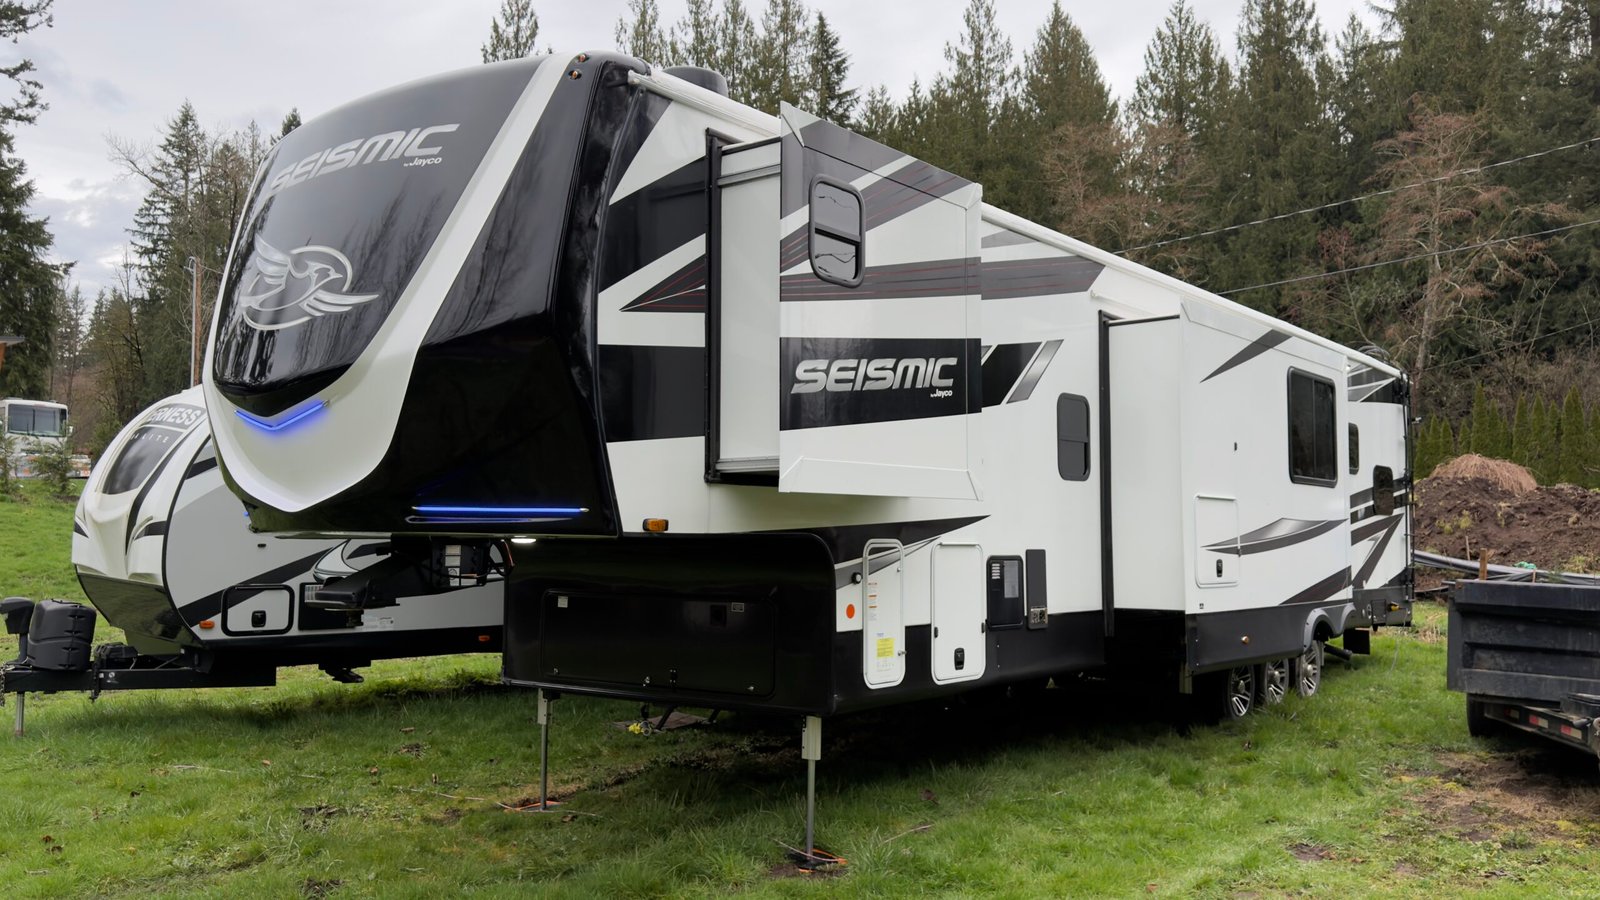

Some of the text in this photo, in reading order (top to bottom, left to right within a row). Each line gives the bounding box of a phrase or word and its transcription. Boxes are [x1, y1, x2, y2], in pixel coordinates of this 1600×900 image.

[265, 123, 461, 198] SEISMIC
[409, 157, 442, 167] Jayco
[790, 357, 958, 395] SEISMIC
[934, 388, 953, 398] Jayco
